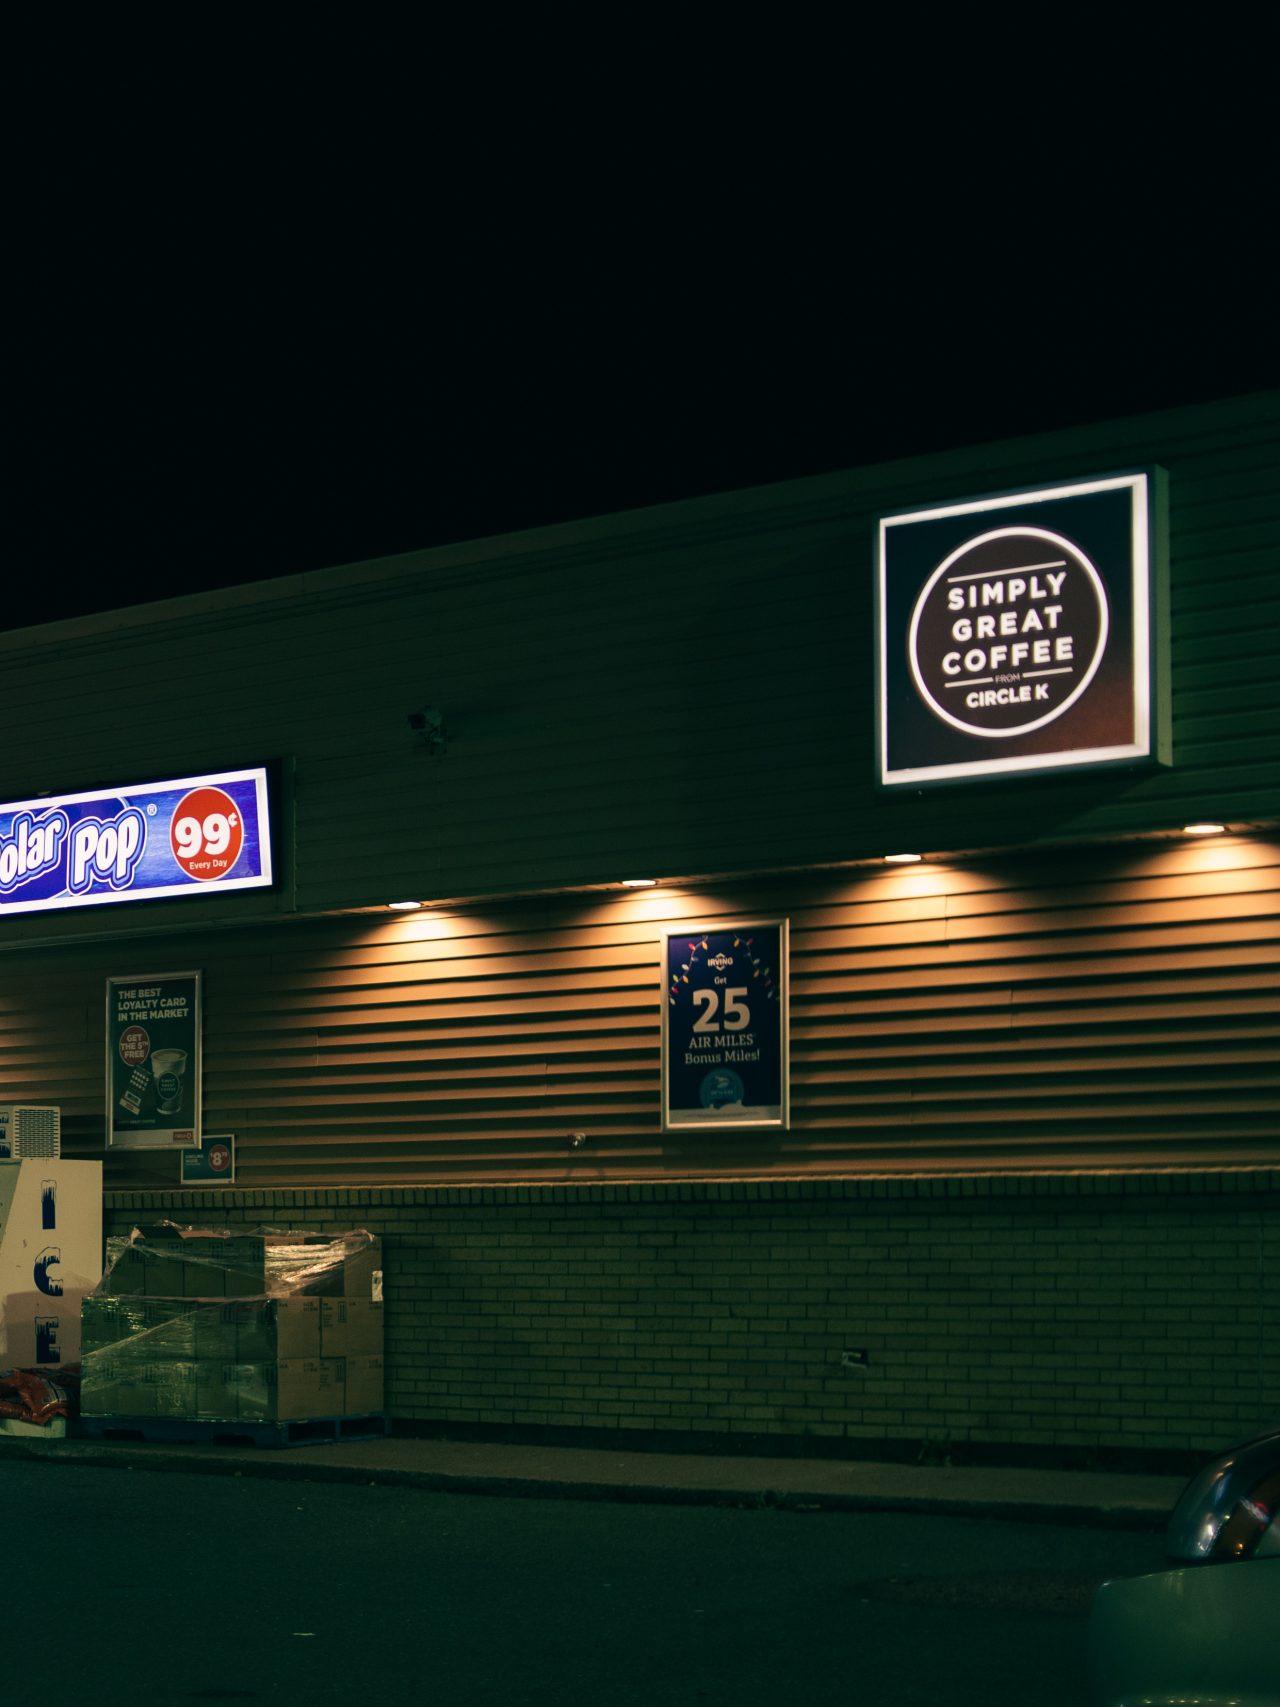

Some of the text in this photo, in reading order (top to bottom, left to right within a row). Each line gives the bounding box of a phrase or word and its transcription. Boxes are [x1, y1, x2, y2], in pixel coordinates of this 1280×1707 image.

[947, 571, 1067, 611] SIMPLY
[952, 604, 1063, 642] GREAT
[941, 635, 1074, 676] COFFEE
[994, 672, 1021, 684] FROM
[965, 683, 1050, 710] CIRCLE K
[73, 814, 140, 886] Pop
[188, 858, 229, 871] Every Day
[707, 956, 734, 968] IRVING
[713, 975, 728, 985] Get
[117, 987, 162, 1000] THE BEST
[117, 996, 187, 1011] LOYALTY CARD
[692, 986, 751, 1033] 25
[117, 1007, 189, 1022] IN THE MARKET
[126, 1033, 142, 1043] GET
[688, 1033, 754, 1050] AIR MILES
[120, 1041, 137, 1051] THE
[124, 1050, 145, 1059] FREE
[684, 1048, 760, 1066] Bonus Miles!
[33, 1179, 64, 1364] ICE
